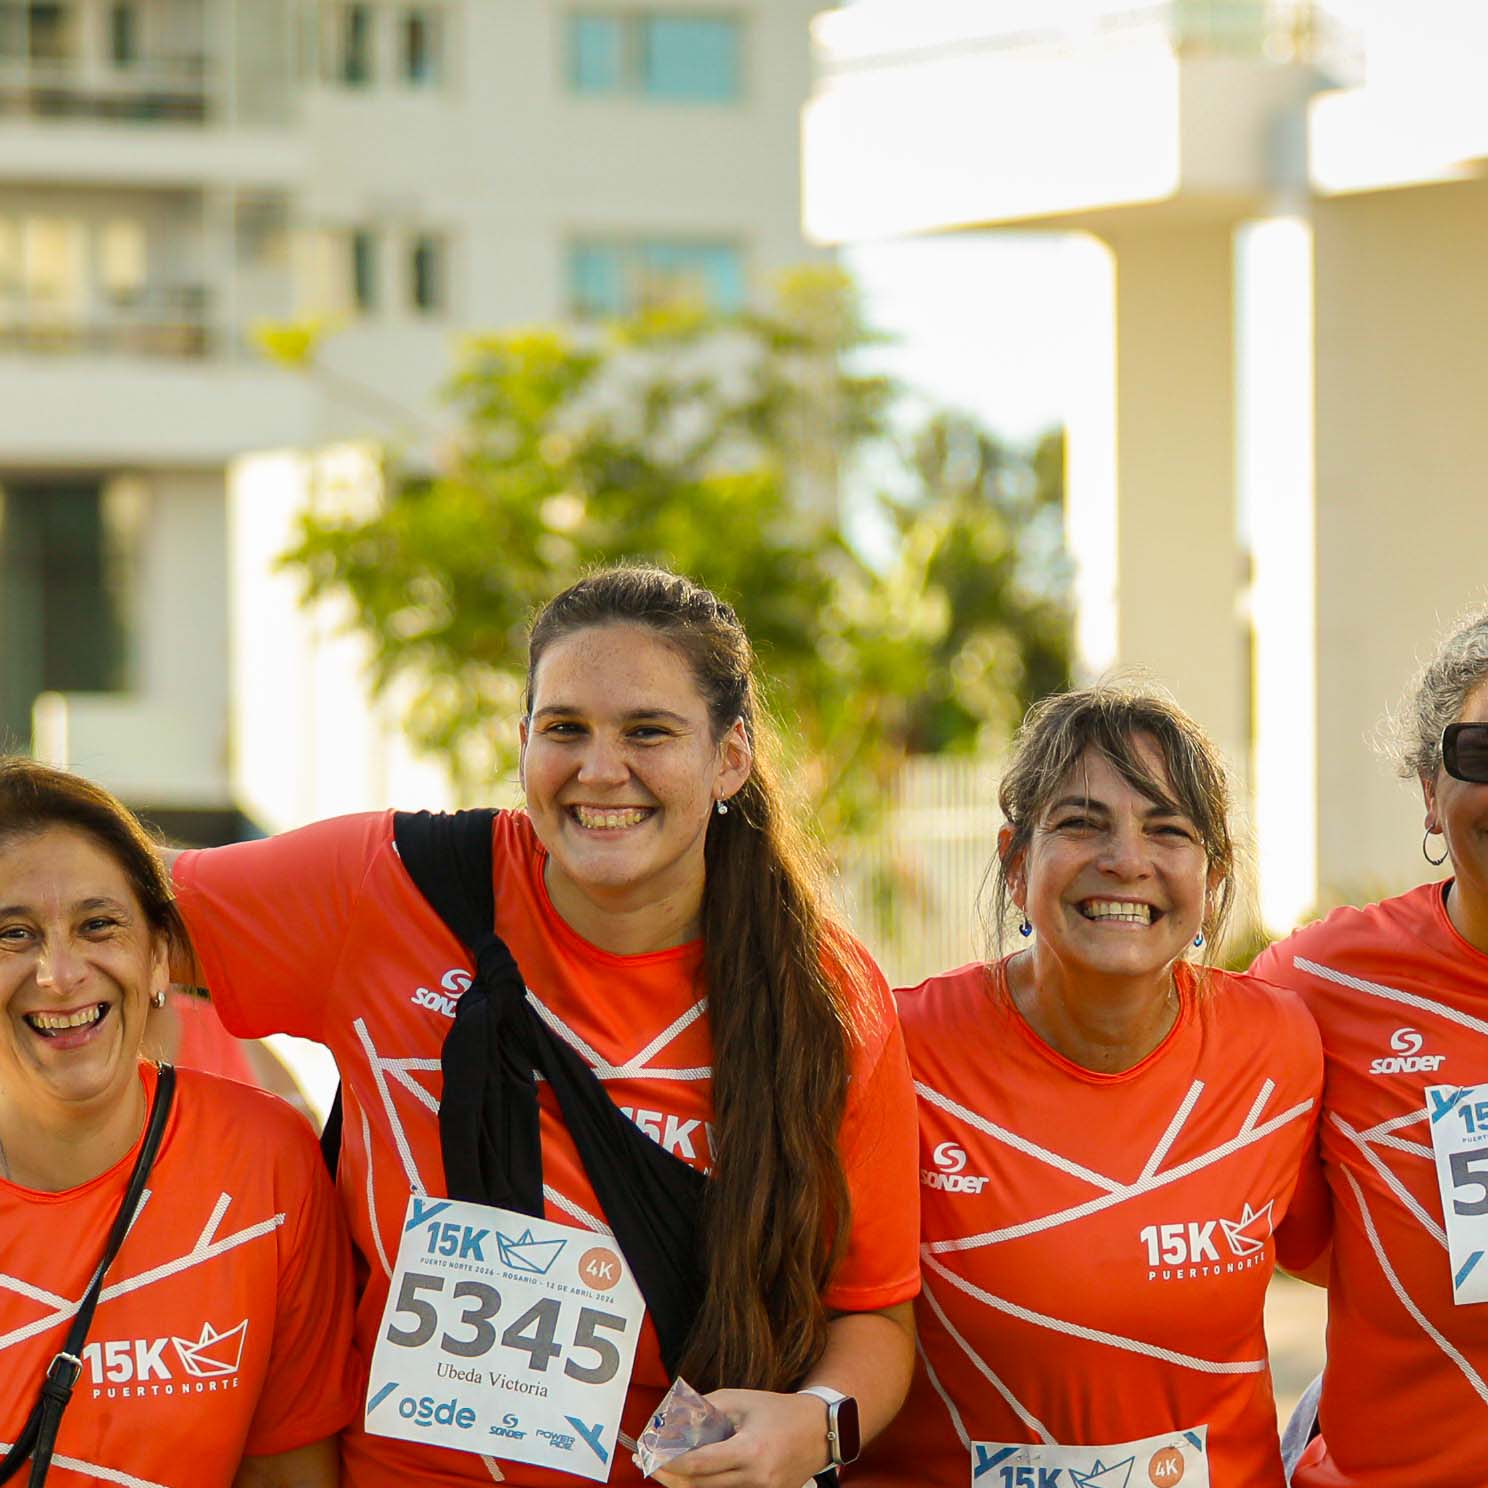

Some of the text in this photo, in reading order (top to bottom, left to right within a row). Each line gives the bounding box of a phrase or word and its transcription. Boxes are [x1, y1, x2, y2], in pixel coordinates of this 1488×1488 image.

[426, 1221, 491, 1262] 15K
[1140, 1220, 1221, 1266] 15K
[419, 1257, 448, 1267] PUERTO
[448, 1261, 473, 1272] NORTE
[475, 1266, 495, 1276] 2026
[502, 1271, 538, 1285] ROSARIO
[546, 1281, 556, 1289] 12
[557, 1284, 568, 1293] DE
[570, 1286, 594, 1299] ABRIL
[595, 1292, 615, 1304] 2026
[585, 1258, 614, 1280] 4K
[1148, 1252, 1265, 1281] PUERTO NORTE
[385, 1270, 628, 1385] 5345
[83, 1337, 174, 1384] 15K
[92, 1377, 239, 1399] PUERTO NORTE
[437, 1362, 549, 1398] Ubeda Victoria
[398, 1396, 477, 1429] osde
[535, 1428, 576, 1445] POWER
[1154, 1457, 1178, 1477] 4K
